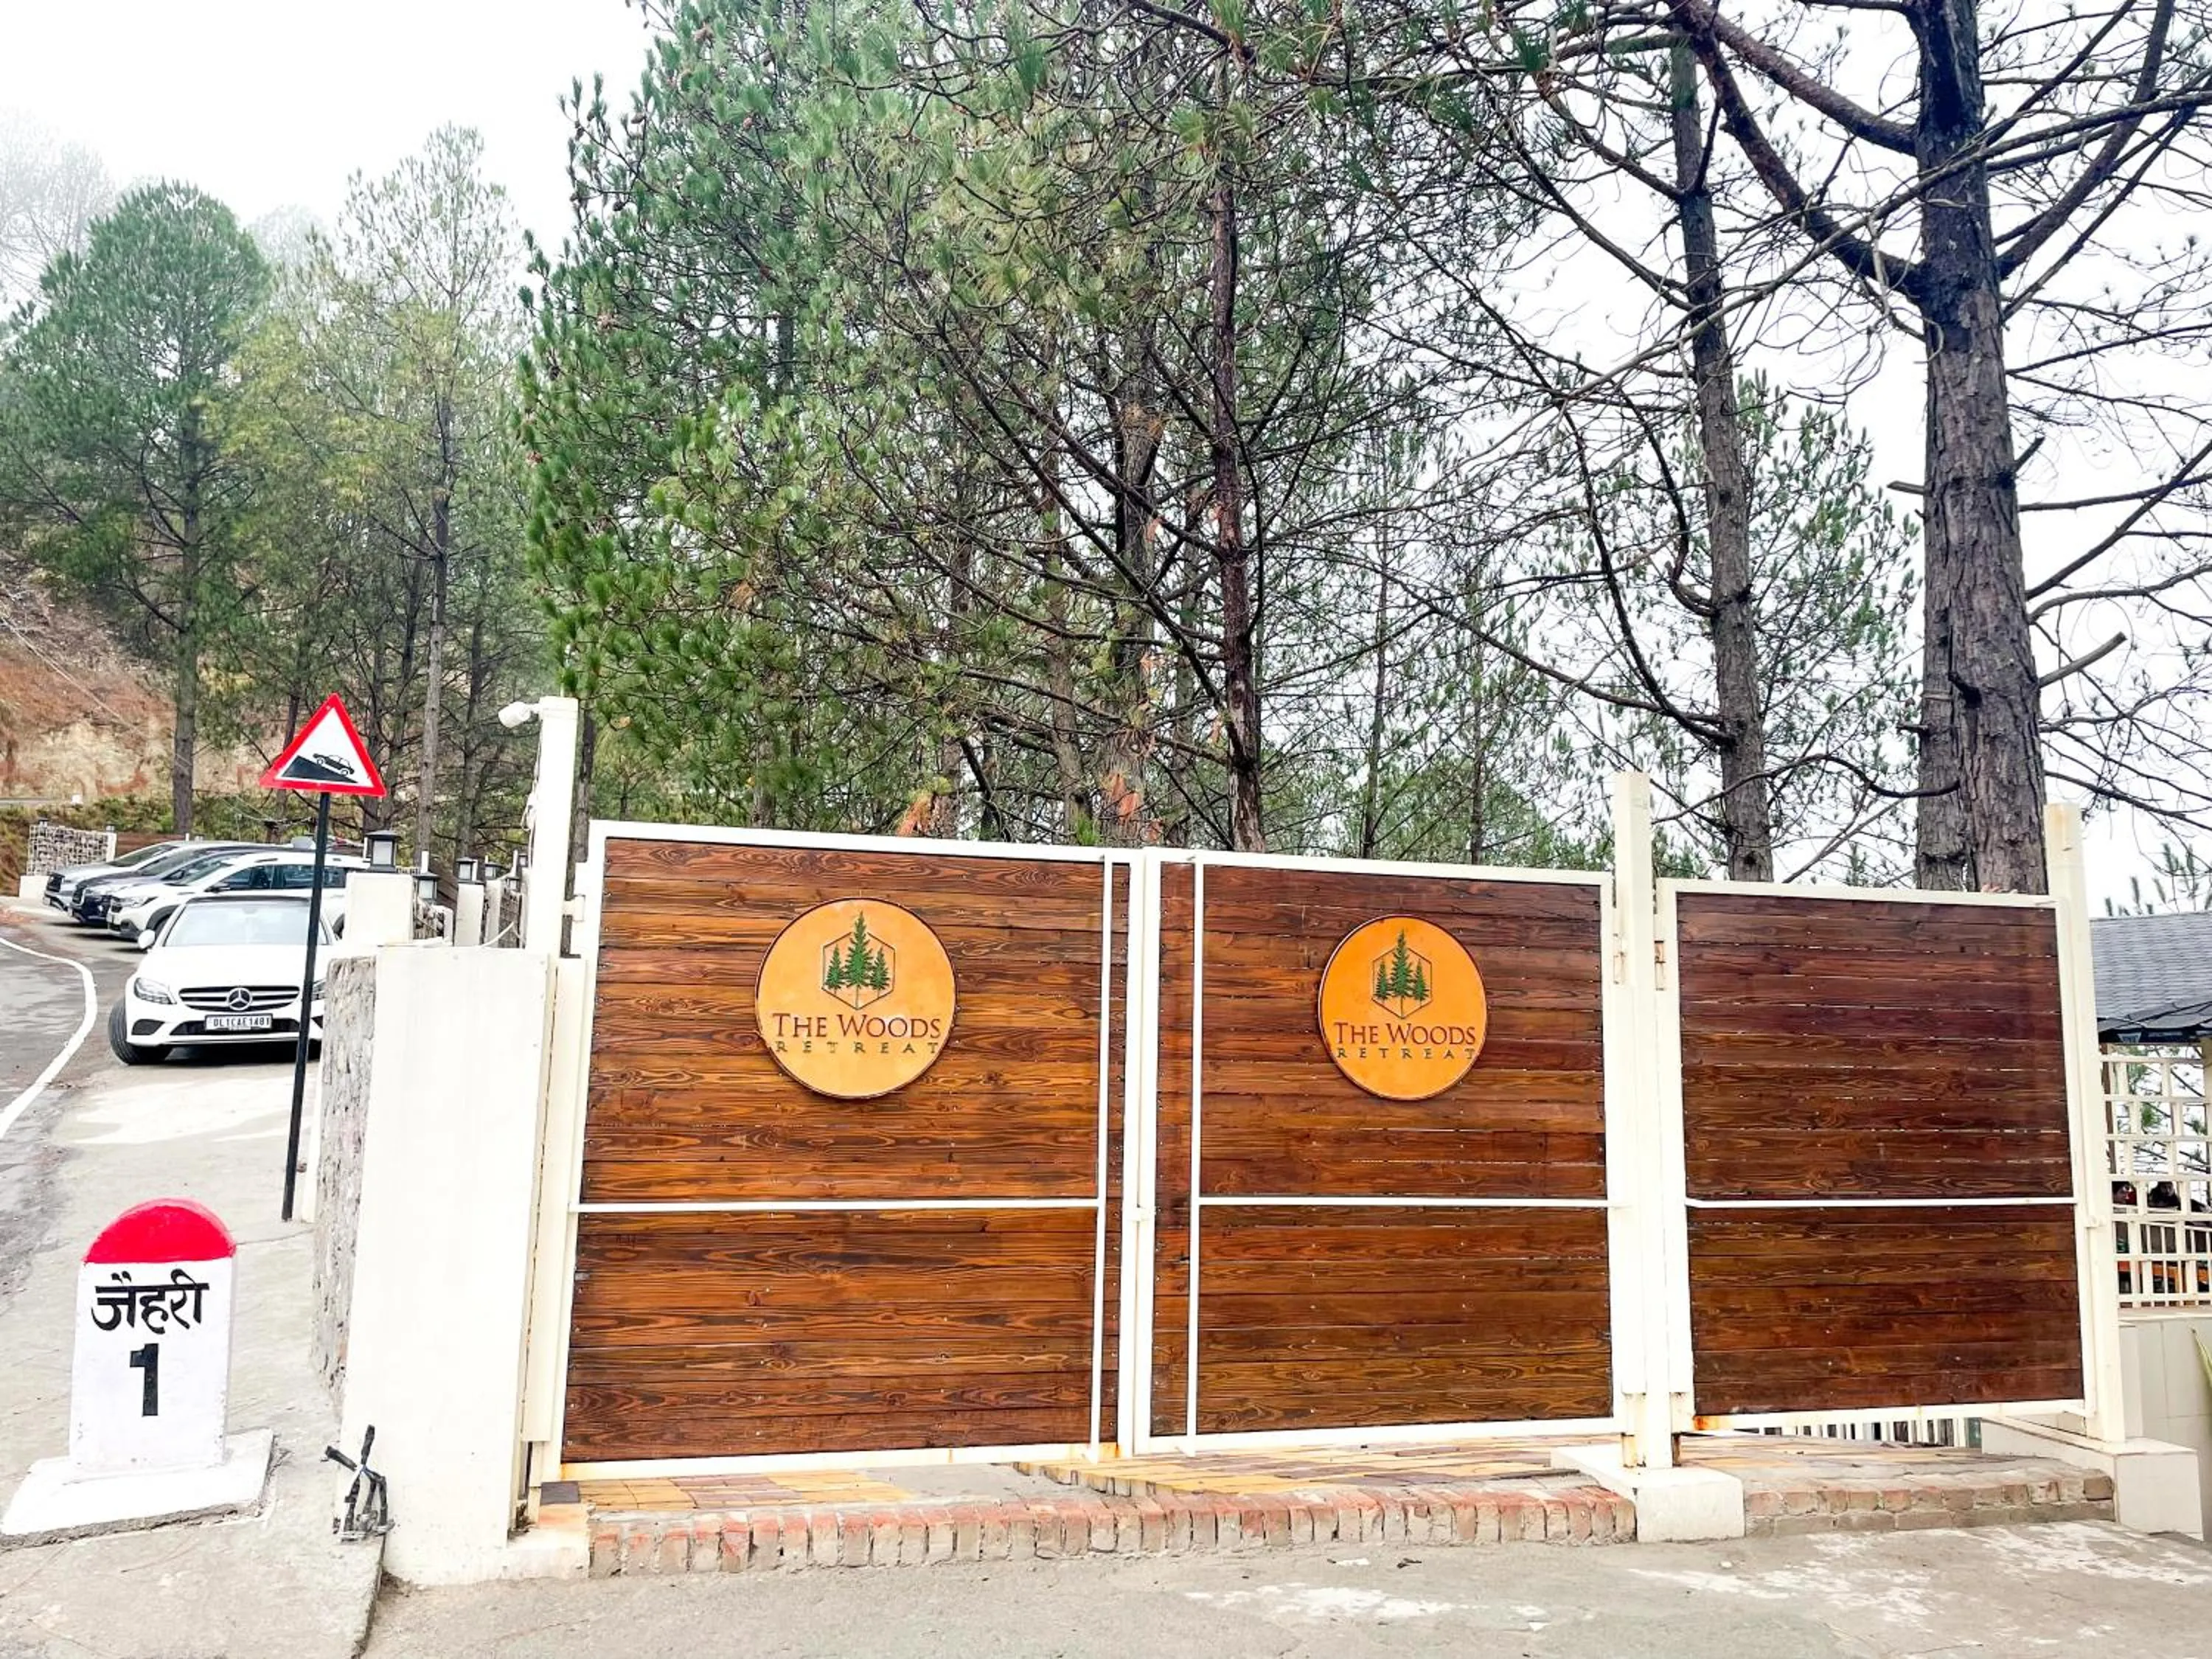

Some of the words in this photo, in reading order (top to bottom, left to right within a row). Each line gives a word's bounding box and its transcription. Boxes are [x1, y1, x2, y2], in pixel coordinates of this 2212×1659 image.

[773, 1013, 827, 1038] THE
[1334, 1022, 1378, 1045] THE
[775, 1041, 939, 1054] RETREAT
[1337, 1048, 1475, 1060] RETREAT
[91, 1268, 210, 1335] जैहरी
[129, 1343, 159, 1416] 1
